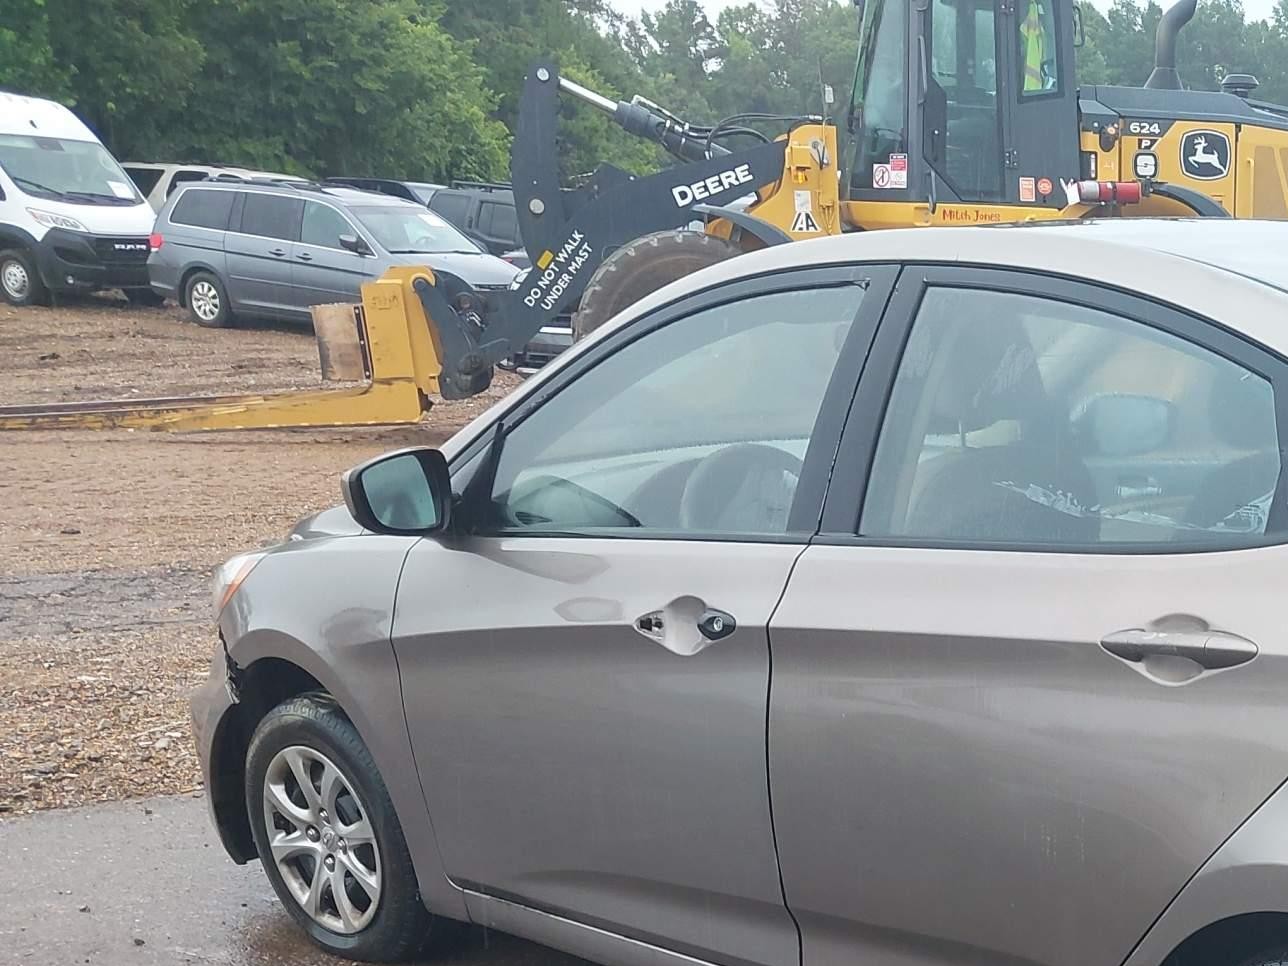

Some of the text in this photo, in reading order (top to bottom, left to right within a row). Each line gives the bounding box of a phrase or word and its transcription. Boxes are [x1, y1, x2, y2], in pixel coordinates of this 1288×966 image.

[1129, 122, 1160, 134] 624
[1141, 140, 1151, 149] P
[672, 164, 754, 207] DEERE
[942, 208, 1000, 221] Mitch Jones
[524, 229, 584, 307] DO NOT WALK
[541, 242, 593, 310] UNDER MAST
